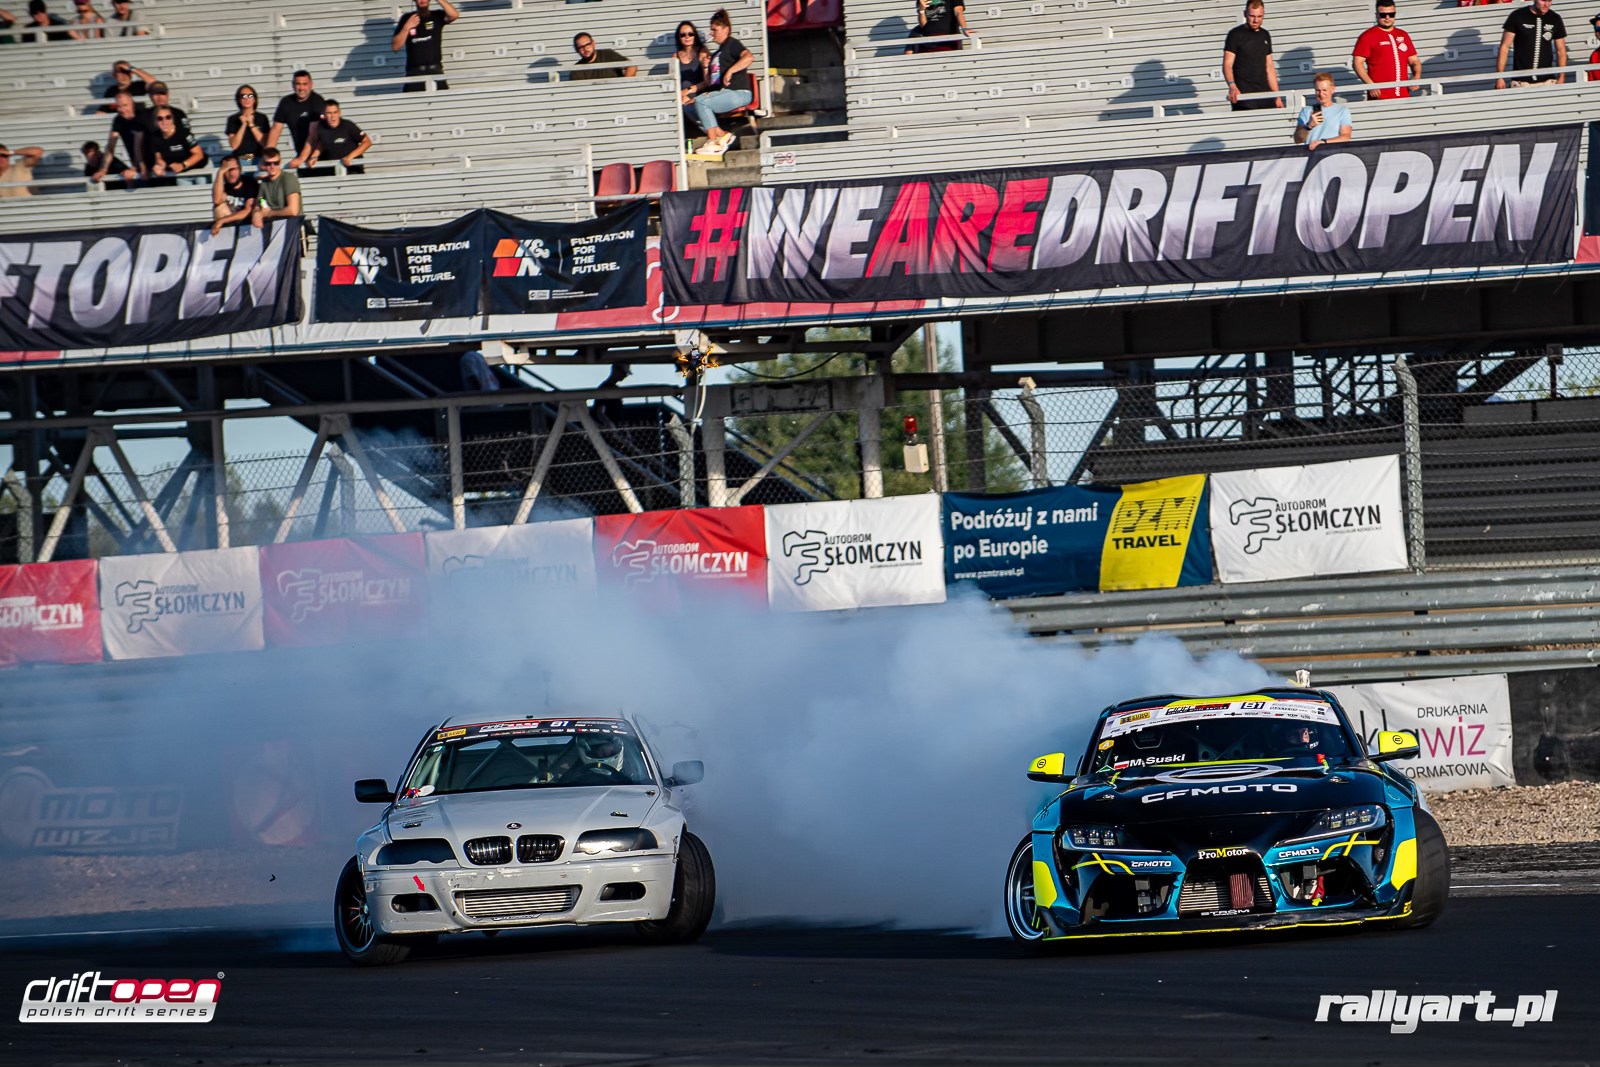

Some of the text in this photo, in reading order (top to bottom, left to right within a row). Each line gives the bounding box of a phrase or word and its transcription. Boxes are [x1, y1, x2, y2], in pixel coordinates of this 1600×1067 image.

[571, 230, 635, 246] FILTRATION
[406, 240, 470, 255] FILTRATION
[572, 245, 595, 254] FOR
[407, 254, 432, 264] FOR
[572, 255, 595, 265] THE
[408, 264, 432, 274] THE
[572, 261, 620, 275] FUTURE.
[410, 271, 456, 284] FUTURE.
[1275, 498, 1327, 512] AUTODROM
[951, 502, 1098, 531] Podróżuj z nami
[1112, 496, 1197, 534] PZM
[1275, 504, 1382, 534] SŁOMCZYN
[824, 533, 872, 545] AUTODROM
[1112, 533, 1182, 550] TRAVEL
[652, 542, 699, 555] AUTODROM
[824, 540, 923, 566] SŁOMCZYN
[953, 534, 1049, 565] po Europie
[651, 551, 748, 576] SŁOMCZYN
[954, 567, 1024, 579] www.pzmtravel.pl
[318, 577, 411, 604] SŁOMCZYN
[154, 591, 245, 616] SŁOMCZYN
[1417, 703, 1488, 719] DRUKARNIA
[1146, 753, 1186, 765] Suski
[1399, 762, 1491, 779] ORMATOWA
[1141, 783, 1298, 805] CFMOTO
[39, 791, 181, 820] MOTO
[34, 825, 172, 848] WIZJA
[1198, 848, 1249, 860] ProMotor
[1277, 847, 1320, 858] CFMOTO
[1131, 860, 1172, 868] CFMOTO
